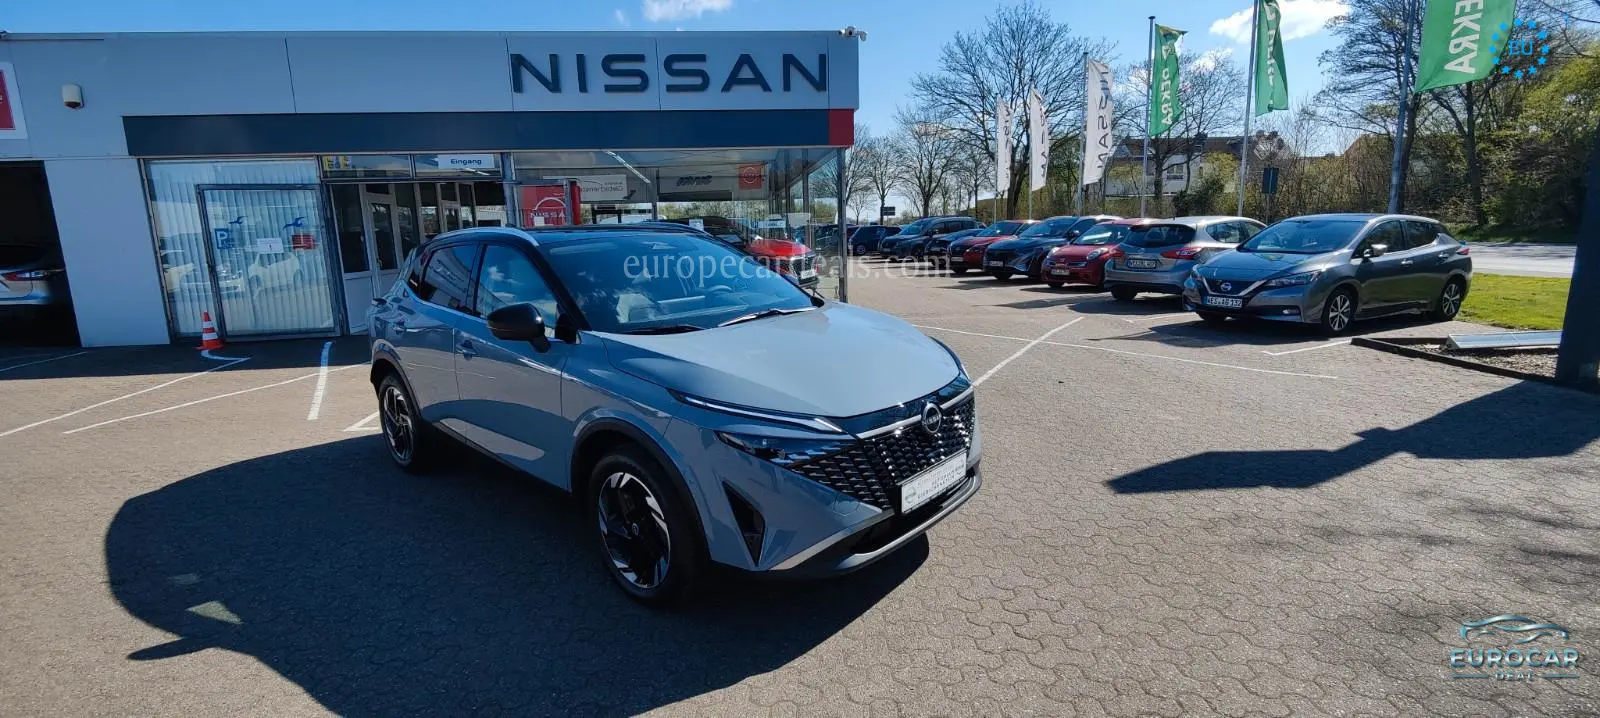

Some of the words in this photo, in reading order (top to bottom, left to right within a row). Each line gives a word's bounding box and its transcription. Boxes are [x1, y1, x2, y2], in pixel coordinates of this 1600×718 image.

[510, 53, 828, 93] NISSAN
[450, 158, 482, 166] Eingang
[530, 211, 566, 219] NISSA
